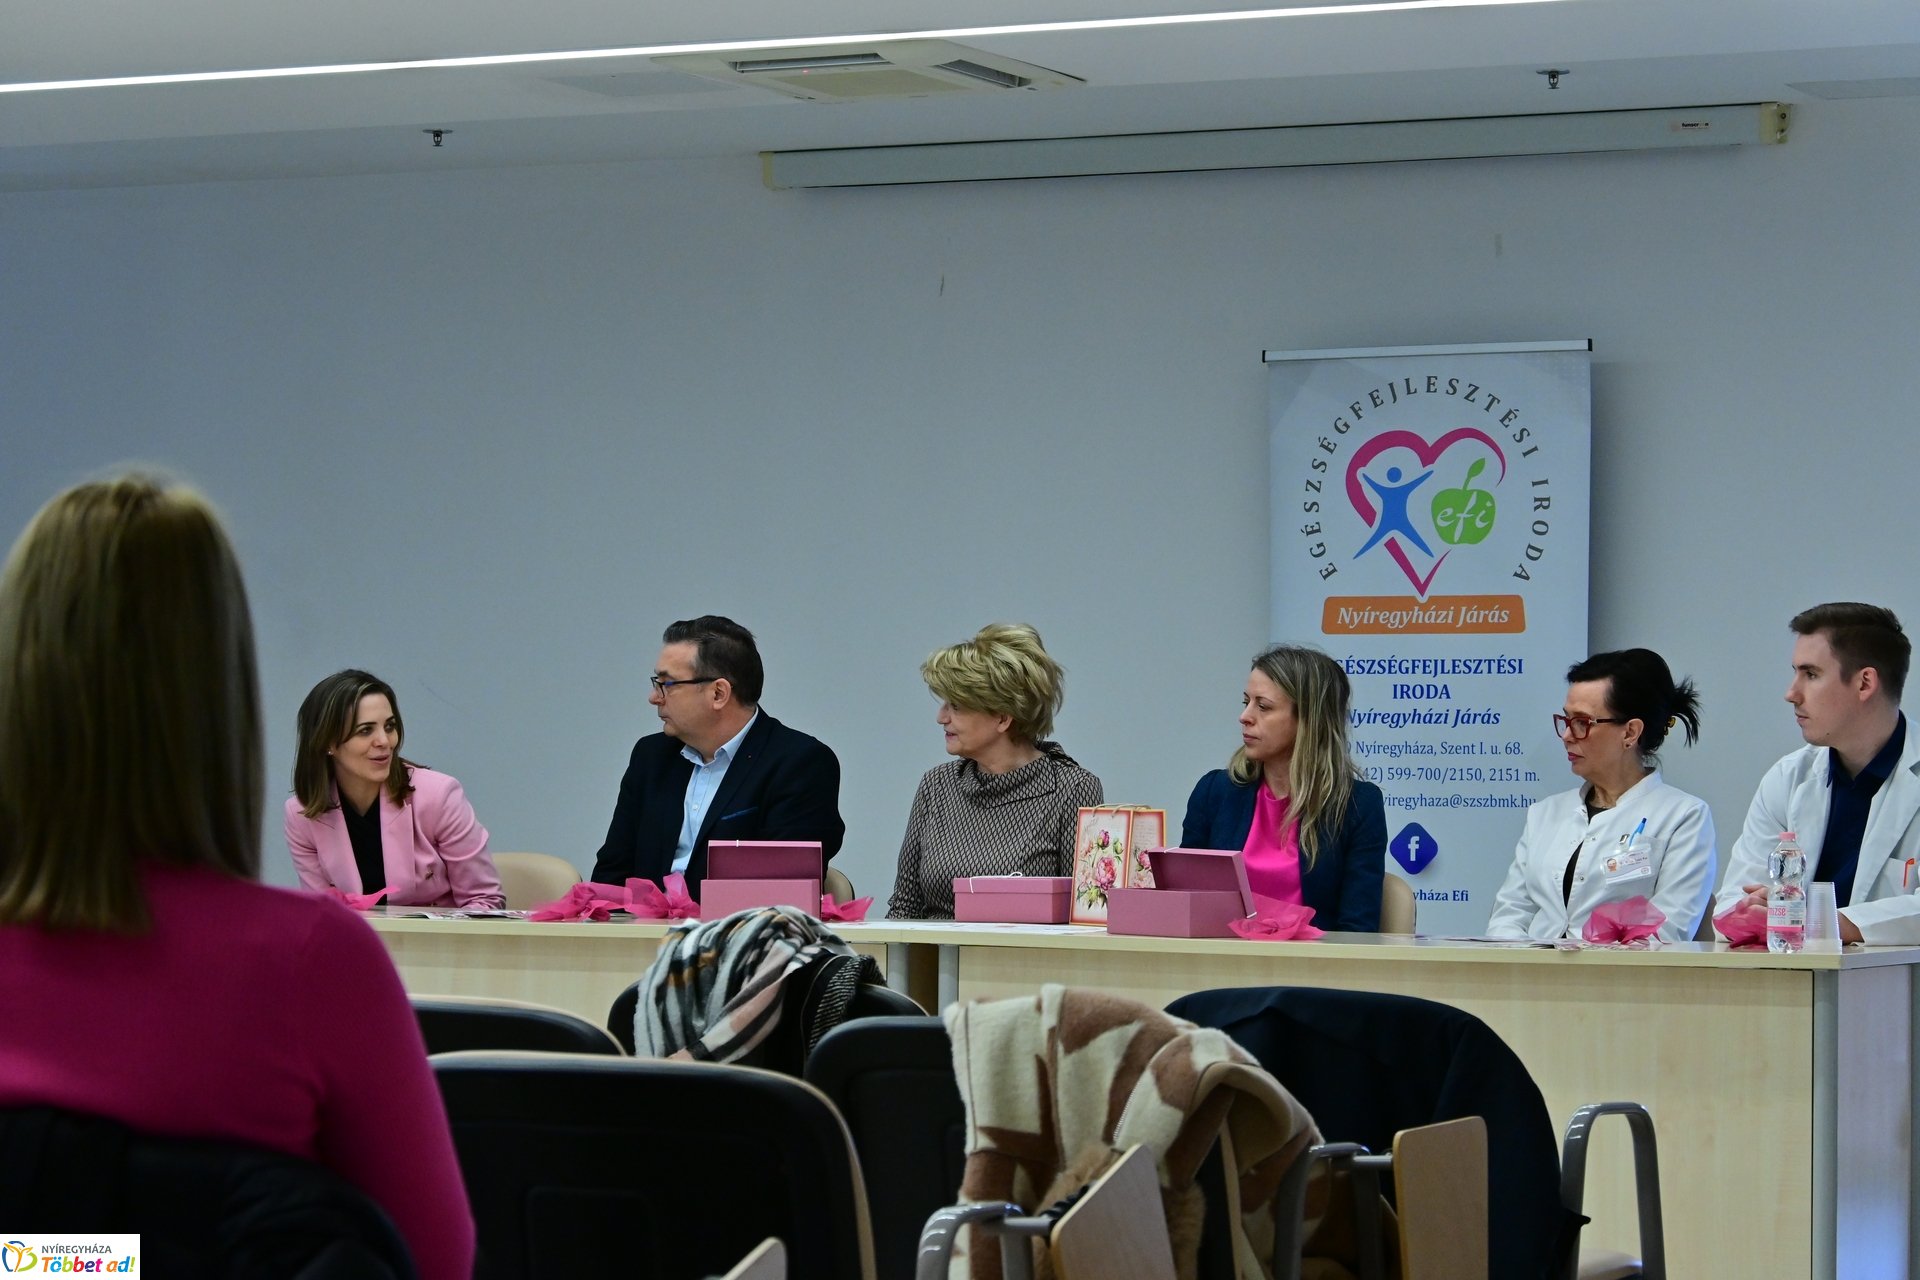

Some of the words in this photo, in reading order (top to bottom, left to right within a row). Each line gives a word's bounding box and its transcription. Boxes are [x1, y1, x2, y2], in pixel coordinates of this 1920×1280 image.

[1300, 375, 1539, 580] EGÉSZSÉGFEJLESZTÉSI
[1512, 477, 1551, 583] IRODA
[1436, 490, 1492, 542] efi
[1337, 606, 1455, 628] Nyíregyházi
[1458, 605, 1510, 627] Járás
[1336, 654, 1523, 678] ÉSZSÉGFEJLESZTÉSI
[1392, 684, 1451, 700] IRODA
[1451, 708, 1500, 727] Járás
[1356, 741, 1437, 758] Nyíregyháza,
[1440, 742, 1476, 755] Szent
[1480, 742, 1487, 755] I.
[1489, 744, 1501, 755] u.
[1505, 742, 1523, 755] 68.
[1387, 767, 1486, 784] 599-700/2150,
[1489, 767, 1521, 782] 2151
[1525, 770, 1540, 782] m.
[1452, 890, 1469, 902] Efi
